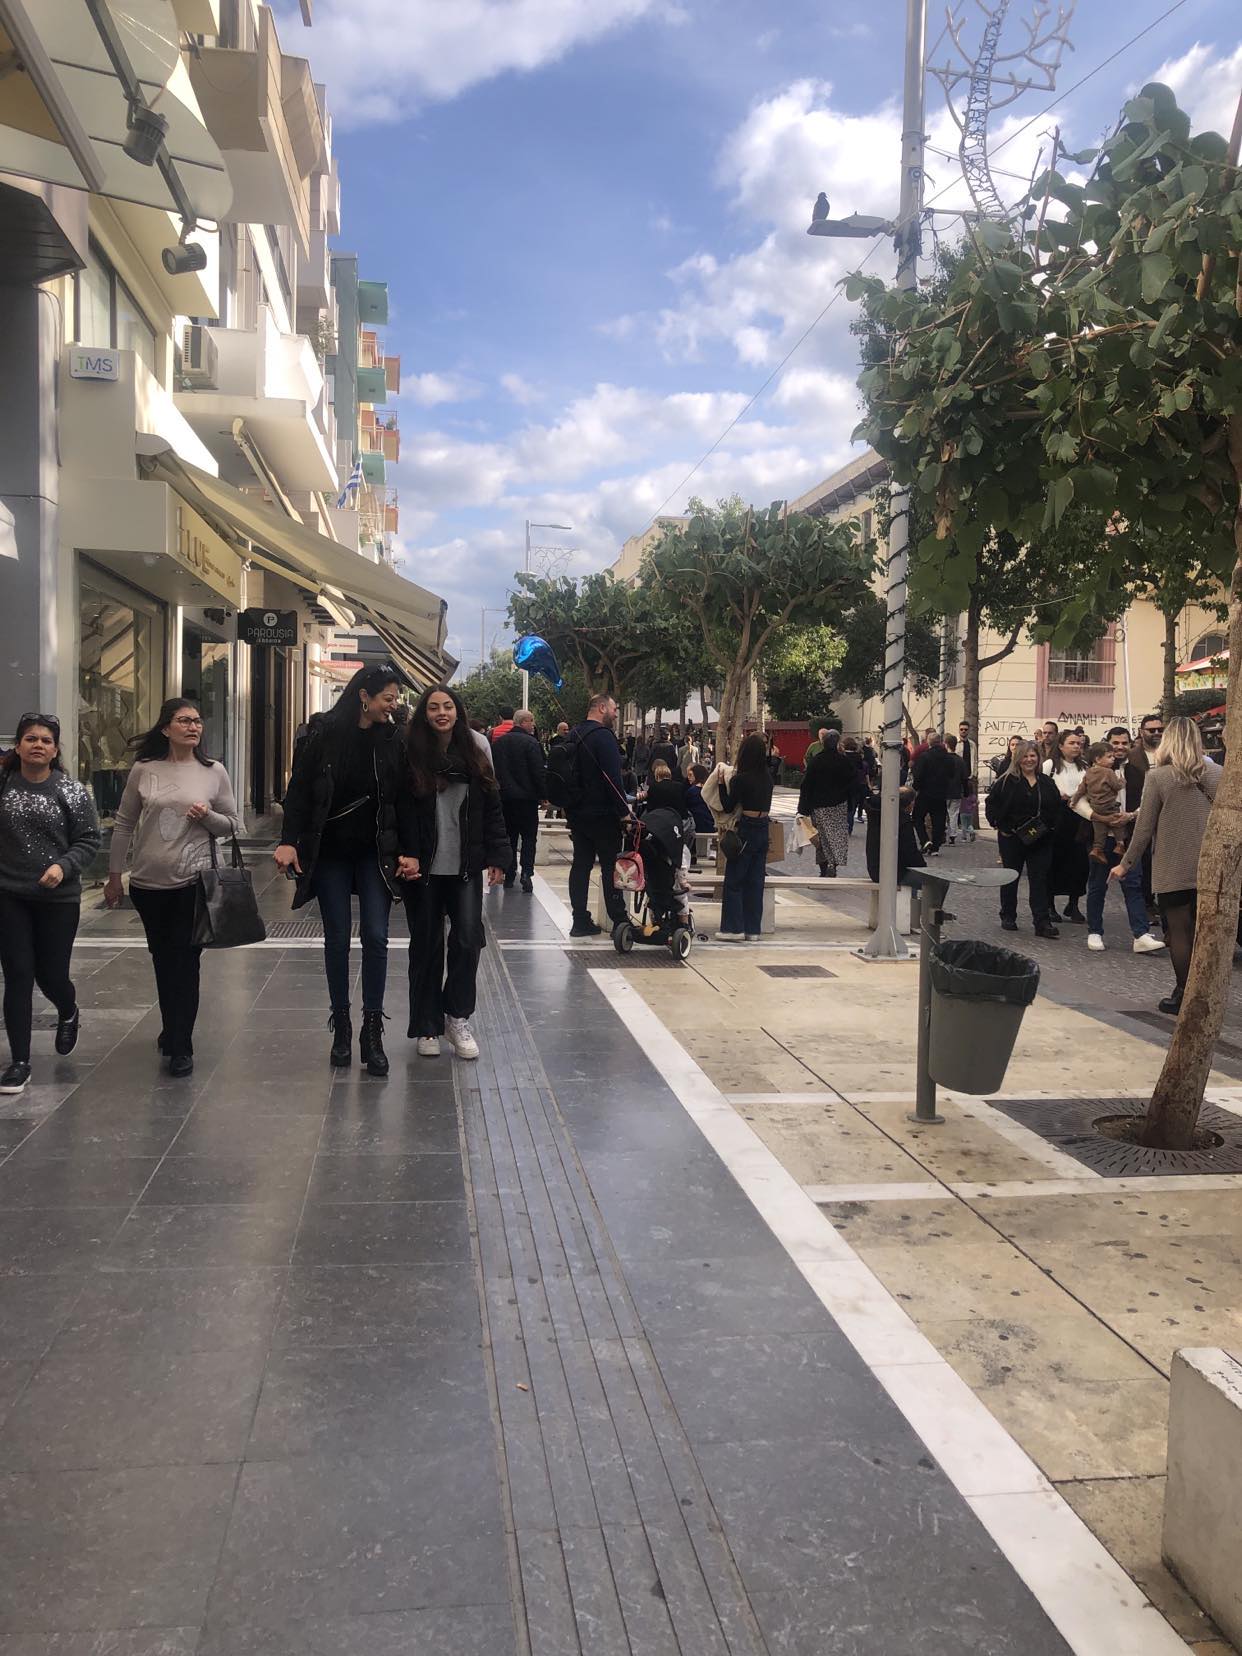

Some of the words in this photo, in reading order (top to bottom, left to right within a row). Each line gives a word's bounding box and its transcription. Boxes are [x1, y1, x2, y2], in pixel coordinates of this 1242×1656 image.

[77, 355, 113, 373] TMS
[247, 627, 294, 639] PAROUSIA
[1057, 711, 1098, 726] ΔΥΝΑΜΗ
[984, 720, 1029, 733] ANTIFA
